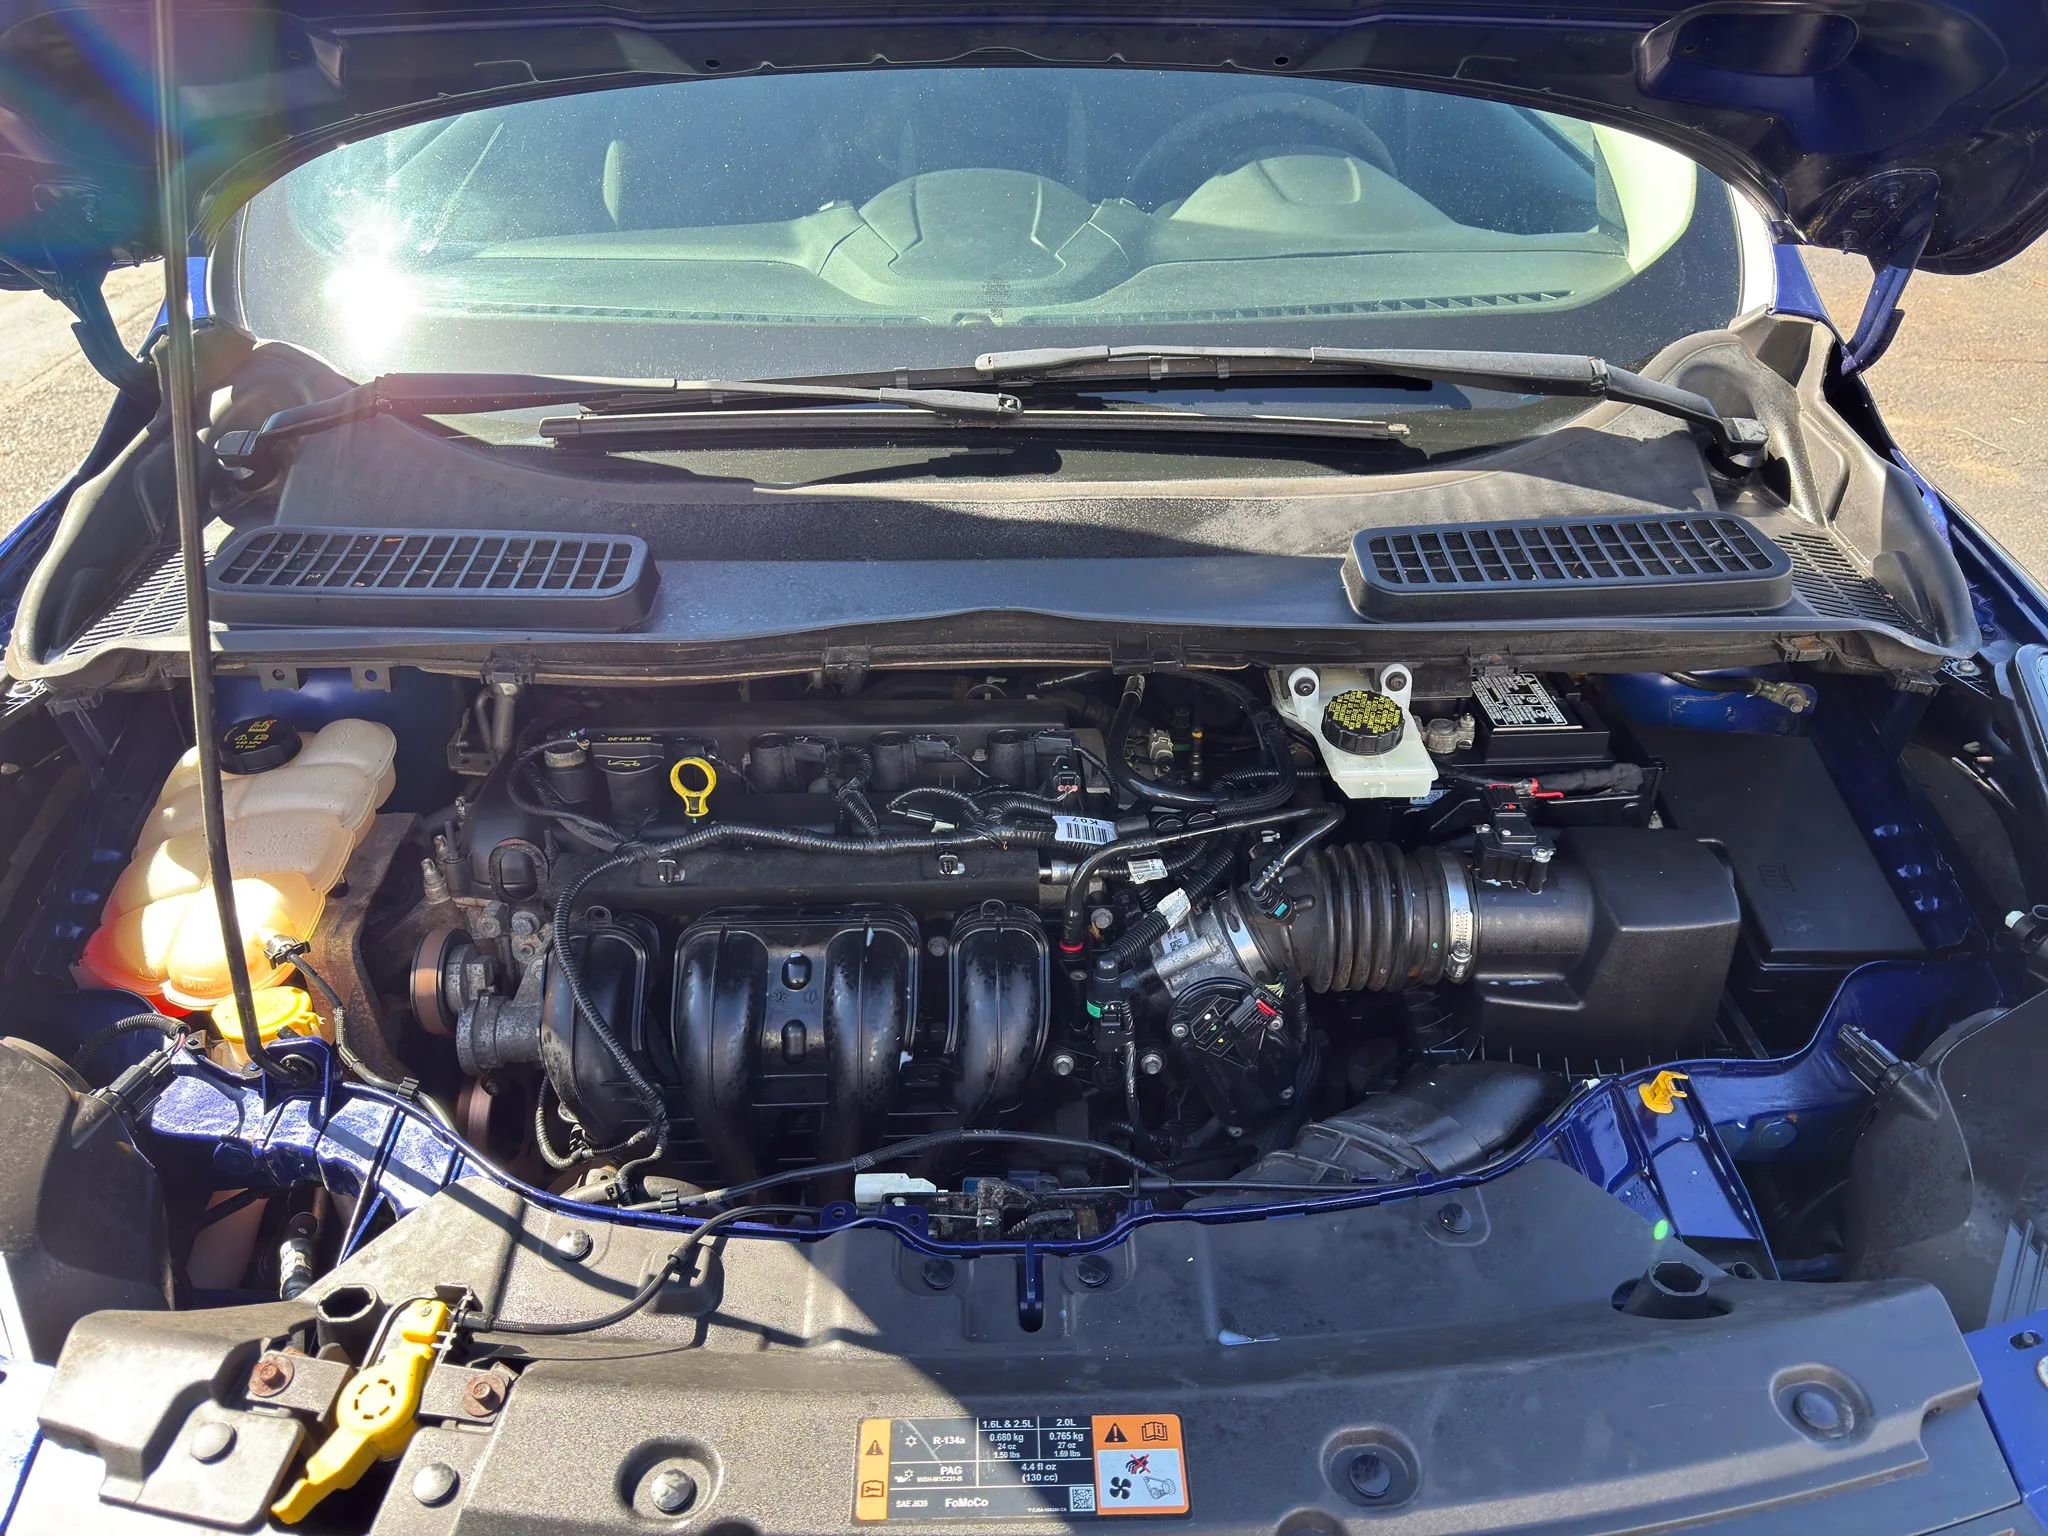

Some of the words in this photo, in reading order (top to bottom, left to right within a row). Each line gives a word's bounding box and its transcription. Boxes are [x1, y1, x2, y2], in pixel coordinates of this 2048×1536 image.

[982, 1420, 1002, 1428] 1.6L
[1004, 1419, 1012, 1428] &
[1013, 1419, 1034, 1428] 2.5L
[1056, 1418, 1077, 1427] 2.0L
[933, 1436, 966, 1445] R-134a
[989, 1433, 1012, 1442] 0.680
[1013, 1433, 1024, 1443] kg
[1049, 1431, 1071, 1441] 0.765
[1073, 1431, 1084, 1442] kg
[997, 1442, 1006, 1450] 24
[1057, 1441, 1066, 1449] 27
[993, 1451, 1008, 1459] 1.50
[940, 1466, 963, 1475] PAG
[1021, 1462, 1035, 1471] 4.4
[1022, 1473, 1042, 1484] (130
[1043, 1472, 1058, 1483] cc)
[895, 1499, 912, 1508] SAE
[945, 1497, 989, 1508] FoMoCo
